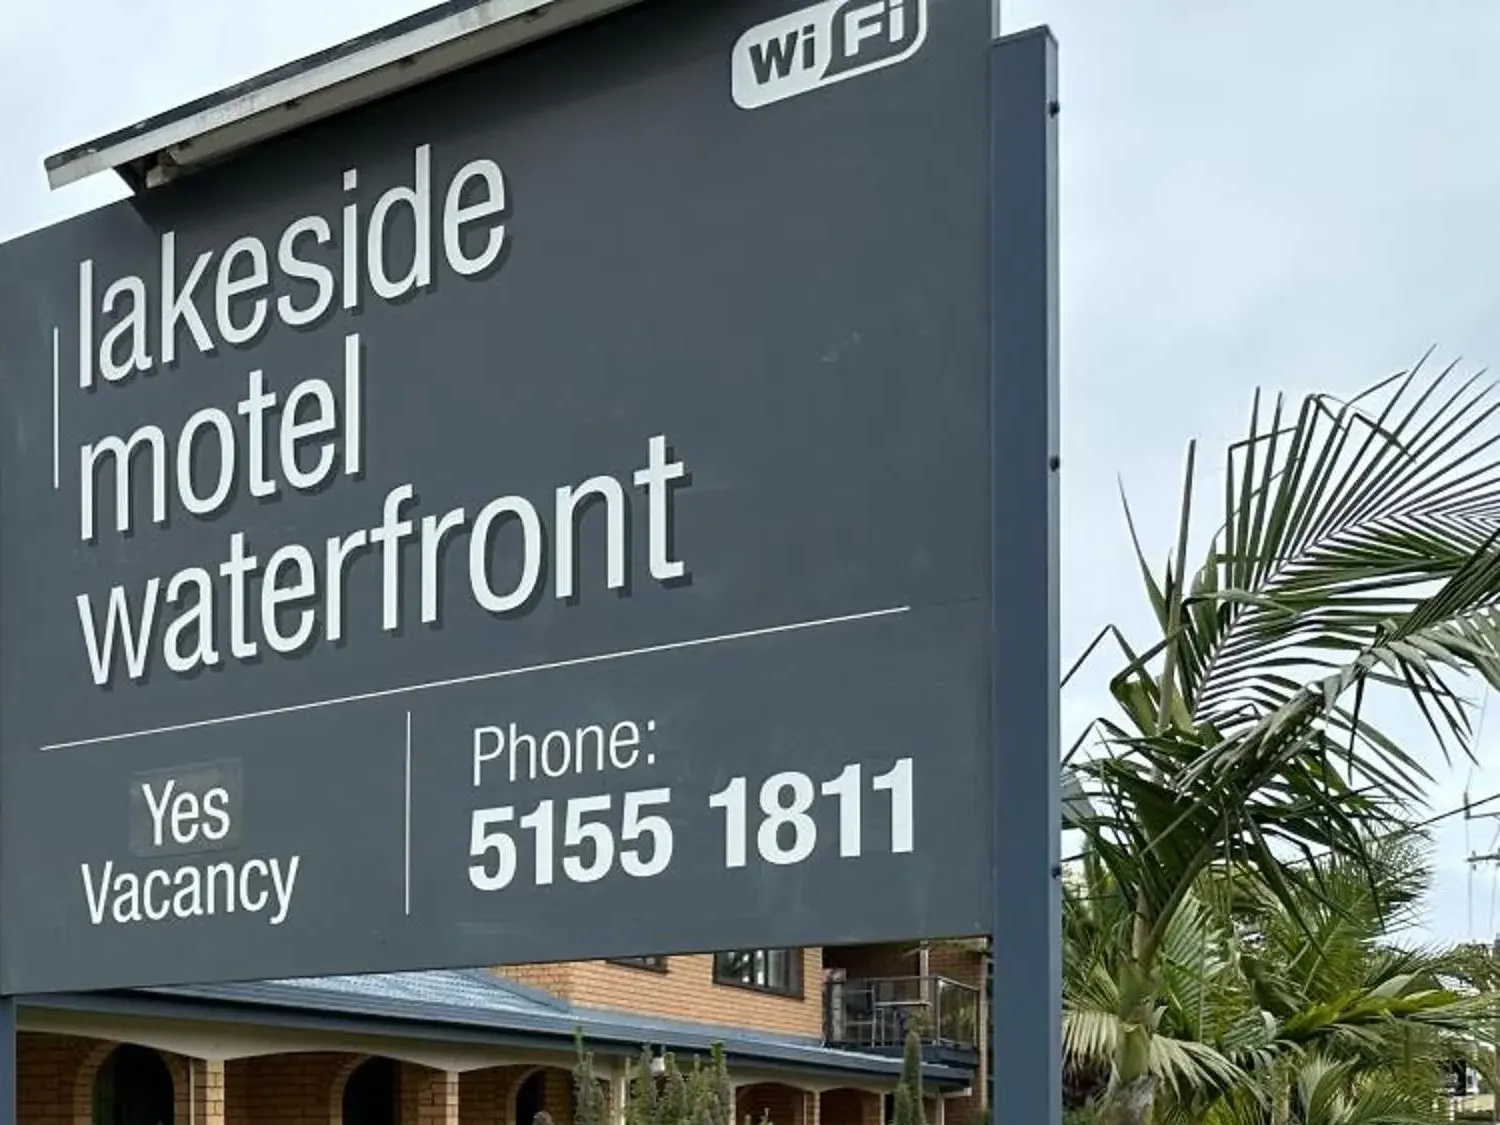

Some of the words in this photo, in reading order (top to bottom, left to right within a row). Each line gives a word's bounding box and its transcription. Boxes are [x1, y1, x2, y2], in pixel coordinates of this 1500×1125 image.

[79, 144, 506, 388] lakeside
[81, 333, 361, 541] motel
[76, 435, 685, 685] waterfront
[141, 779, 231, 846] Yes
[472, 718, 658, 787] Phone:
[81, 855, 300, 925] Vacancy
[468, 787, 673, 891] 5155
[708, 757, 914, 868] 1811
